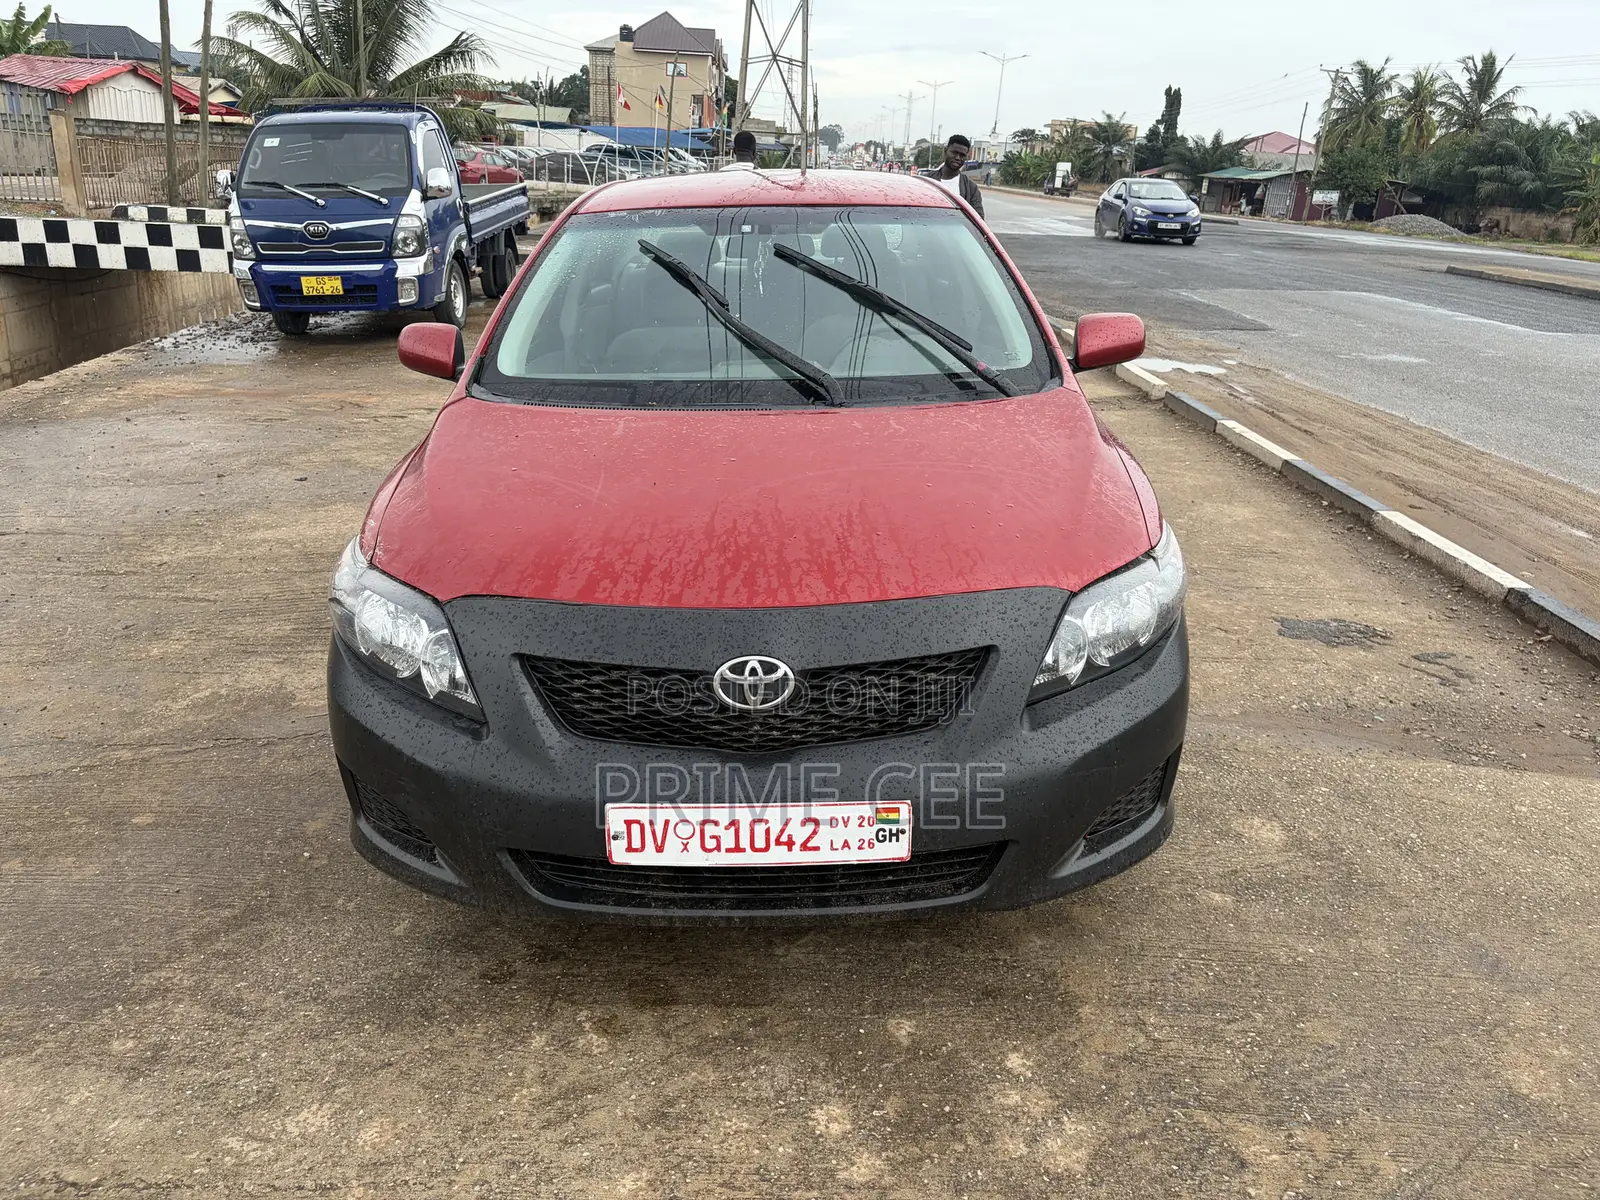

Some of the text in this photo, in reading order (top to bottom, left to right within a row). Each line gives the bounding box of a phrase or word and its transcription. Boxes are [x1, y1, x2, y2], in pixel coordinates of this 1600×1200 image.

[316, 277, 326, 286] GS
[305, 286, 340, 294] 3761-26
[829, 815, 875, 829] DV 20
[700, 816, 821, 853] G1042
[875, 827, 900, 843] GH
[829, 838, 875, 851] LA 26
